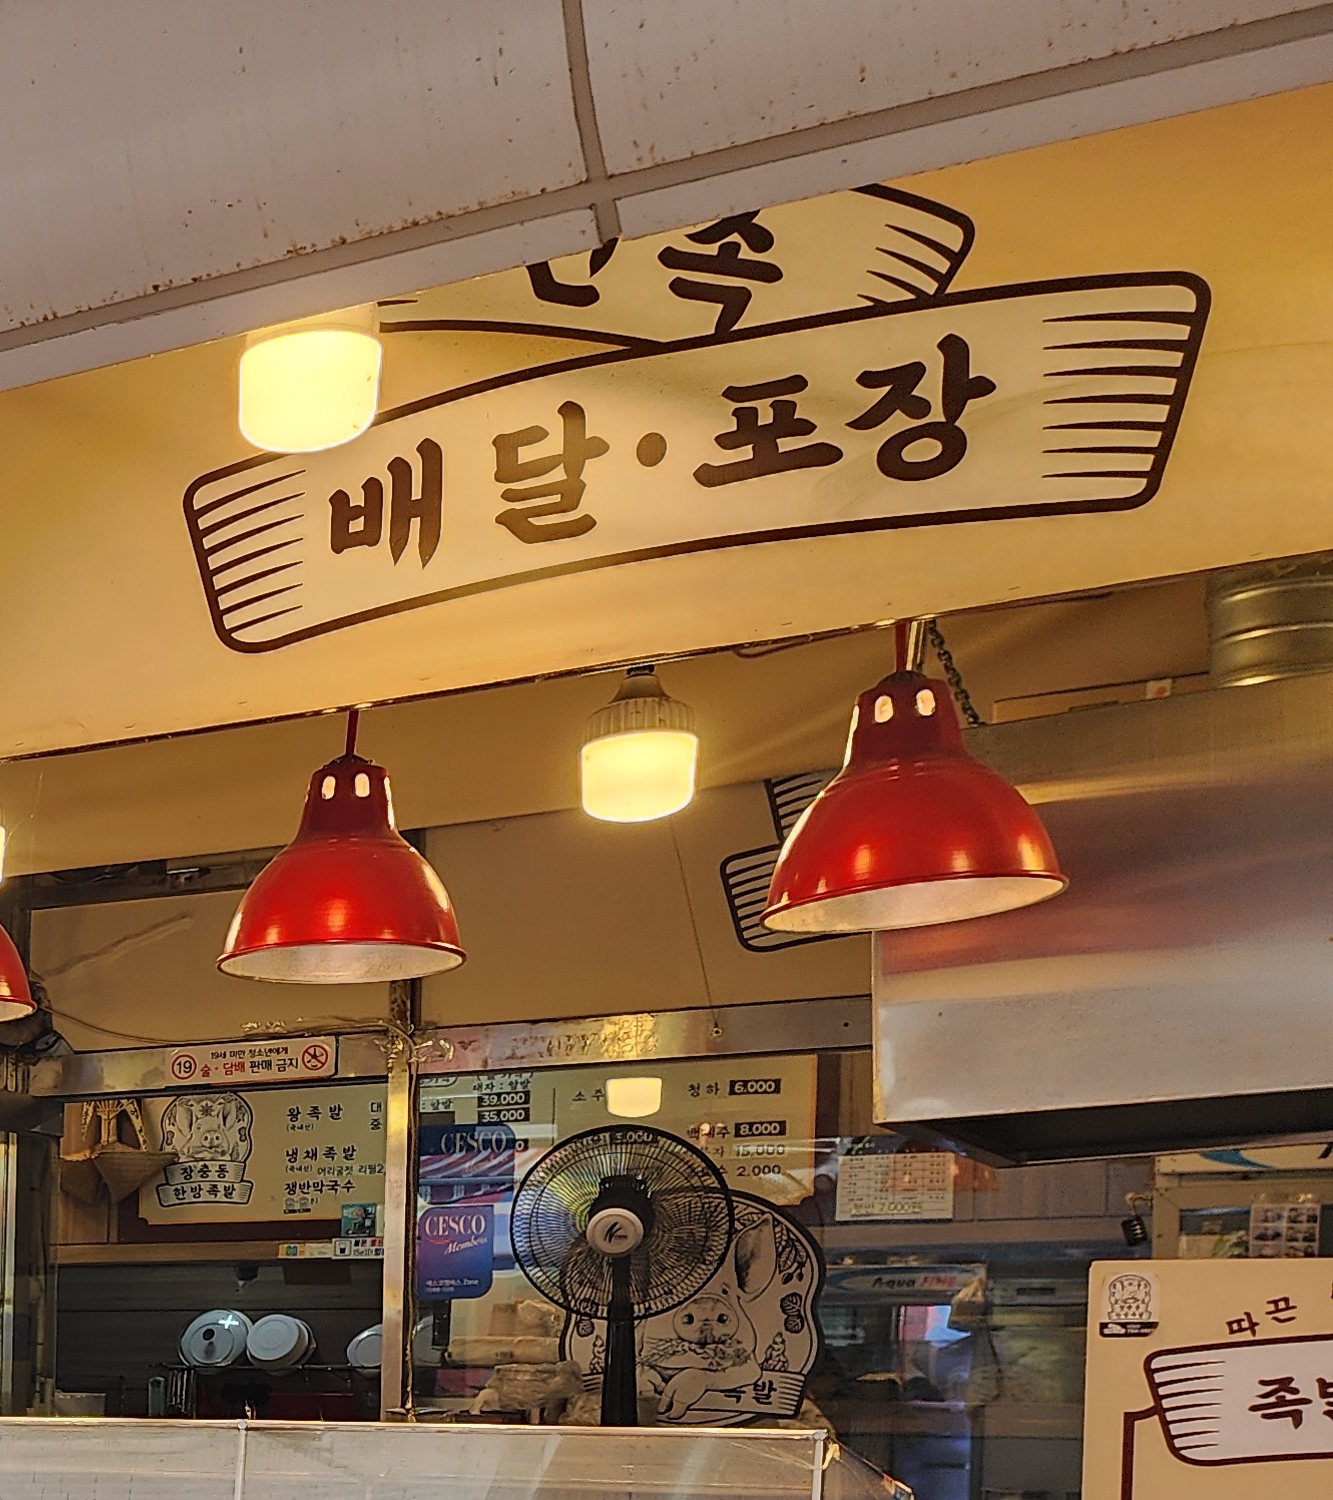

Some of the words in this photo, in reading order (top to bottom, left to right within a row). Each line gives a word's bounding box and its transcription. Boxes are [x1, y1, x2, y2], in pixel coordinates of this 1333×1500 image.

[176, 1060, 193, 1075] 19
[248, 1059, 273, 1074] 판매
[276, 1057, 299, 1073] 금지
[687, 1081, 721, 1098] 청하
[370, 1101, 383, 1114] 대
[370, 1117, 383, 1131] 중
[441, 1130, 507, 1154] CESCO
[180, 1163, 230, 1181] 장충동
[172, 1184, 236, 1201] 한방족발
[284, 1179, 356, 1196] 쟁반막국수
[425, 1213, 486, 1237] CESCO
